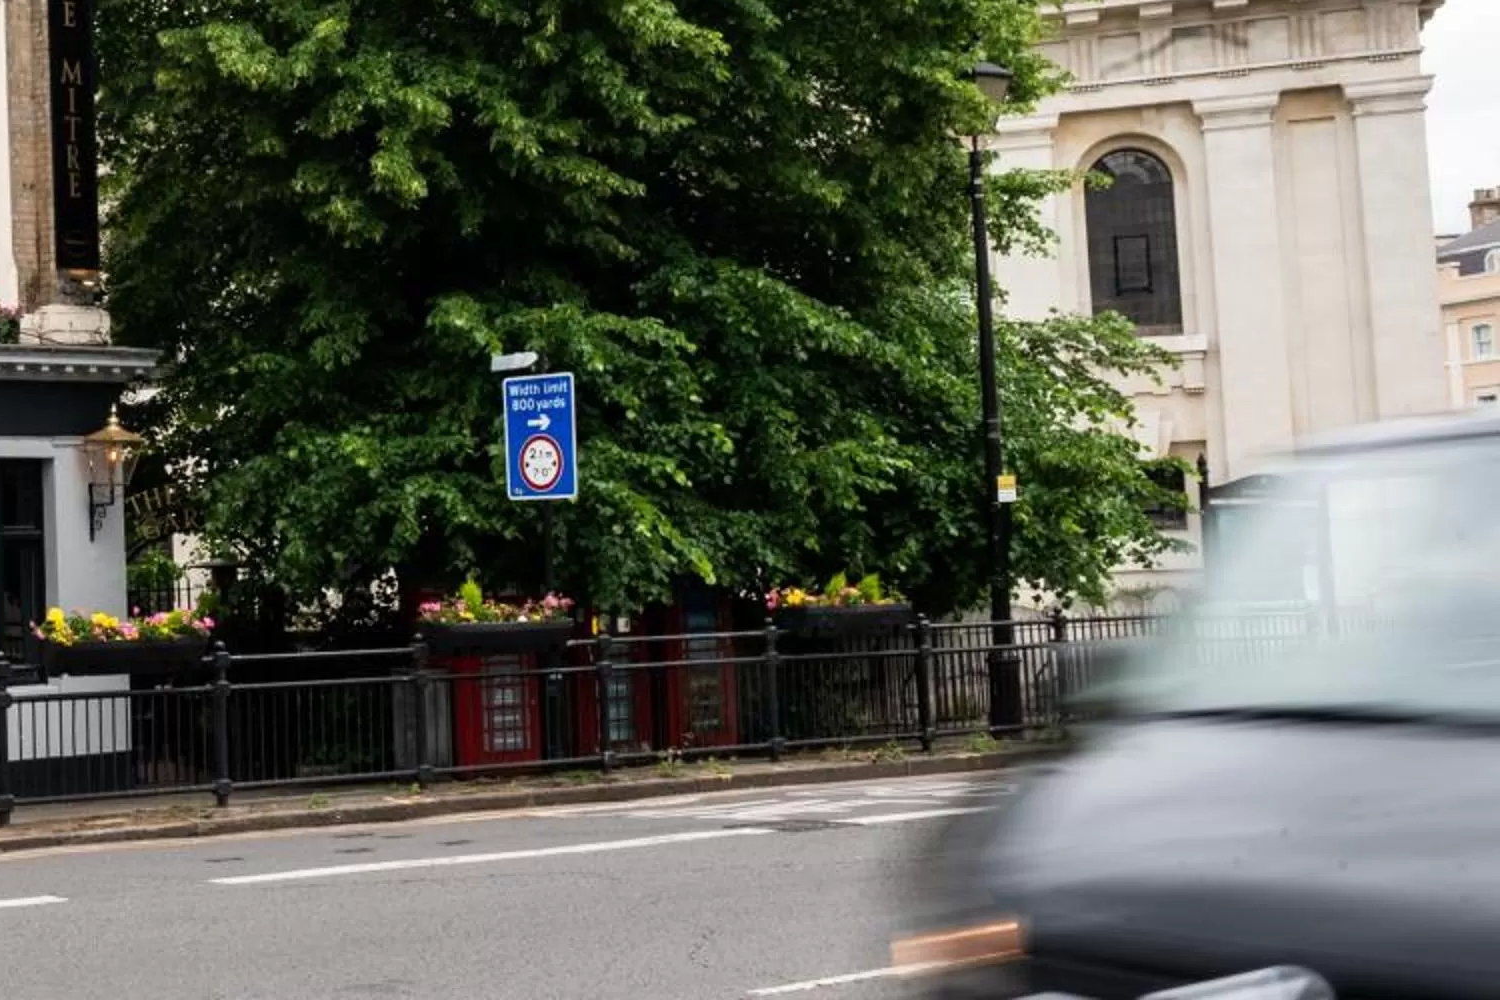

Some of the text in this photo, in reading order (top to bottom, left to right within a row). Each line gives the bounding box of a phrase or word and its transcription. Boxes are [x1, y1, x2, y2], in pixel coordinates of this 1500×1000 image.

[60, 58, 83, 199] MITRE
[509, 380, 568, 396] Width limit
[512, 397, 565, 412] 800 yards
[125, 484, 177, 515] THE
